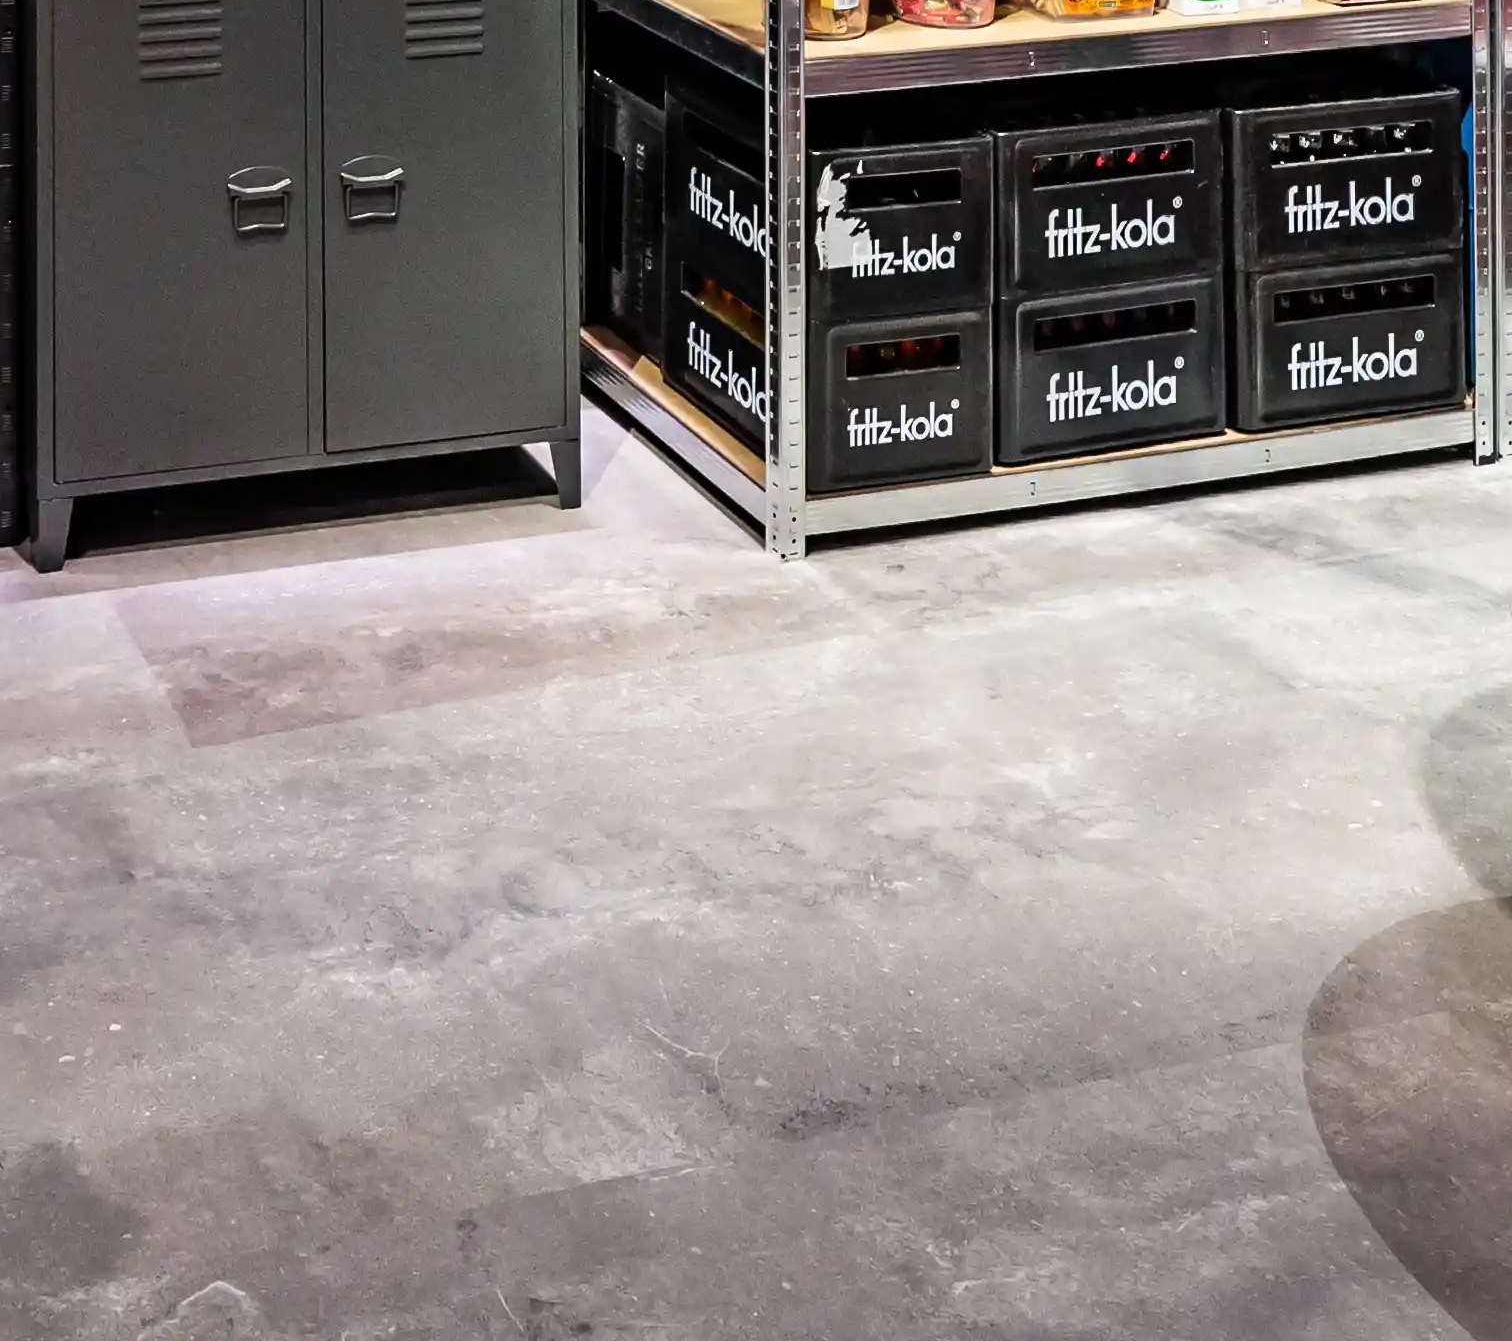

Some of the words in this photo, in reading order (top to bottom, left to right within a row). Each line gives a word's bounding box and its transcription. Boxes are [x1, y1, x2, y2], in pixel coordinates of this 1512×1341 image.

[1045, 198, 1175, 259] fritz-kola
[1284, 176, 1415, 233] fritz-kola
[851, 233, 956, 278] fritz-kola
[1287, 332, 1418, 390] fritz-kola
[1046, 360, 1177, 422] fritz-kola
[847, 402, 954, 448] fritz-kola
